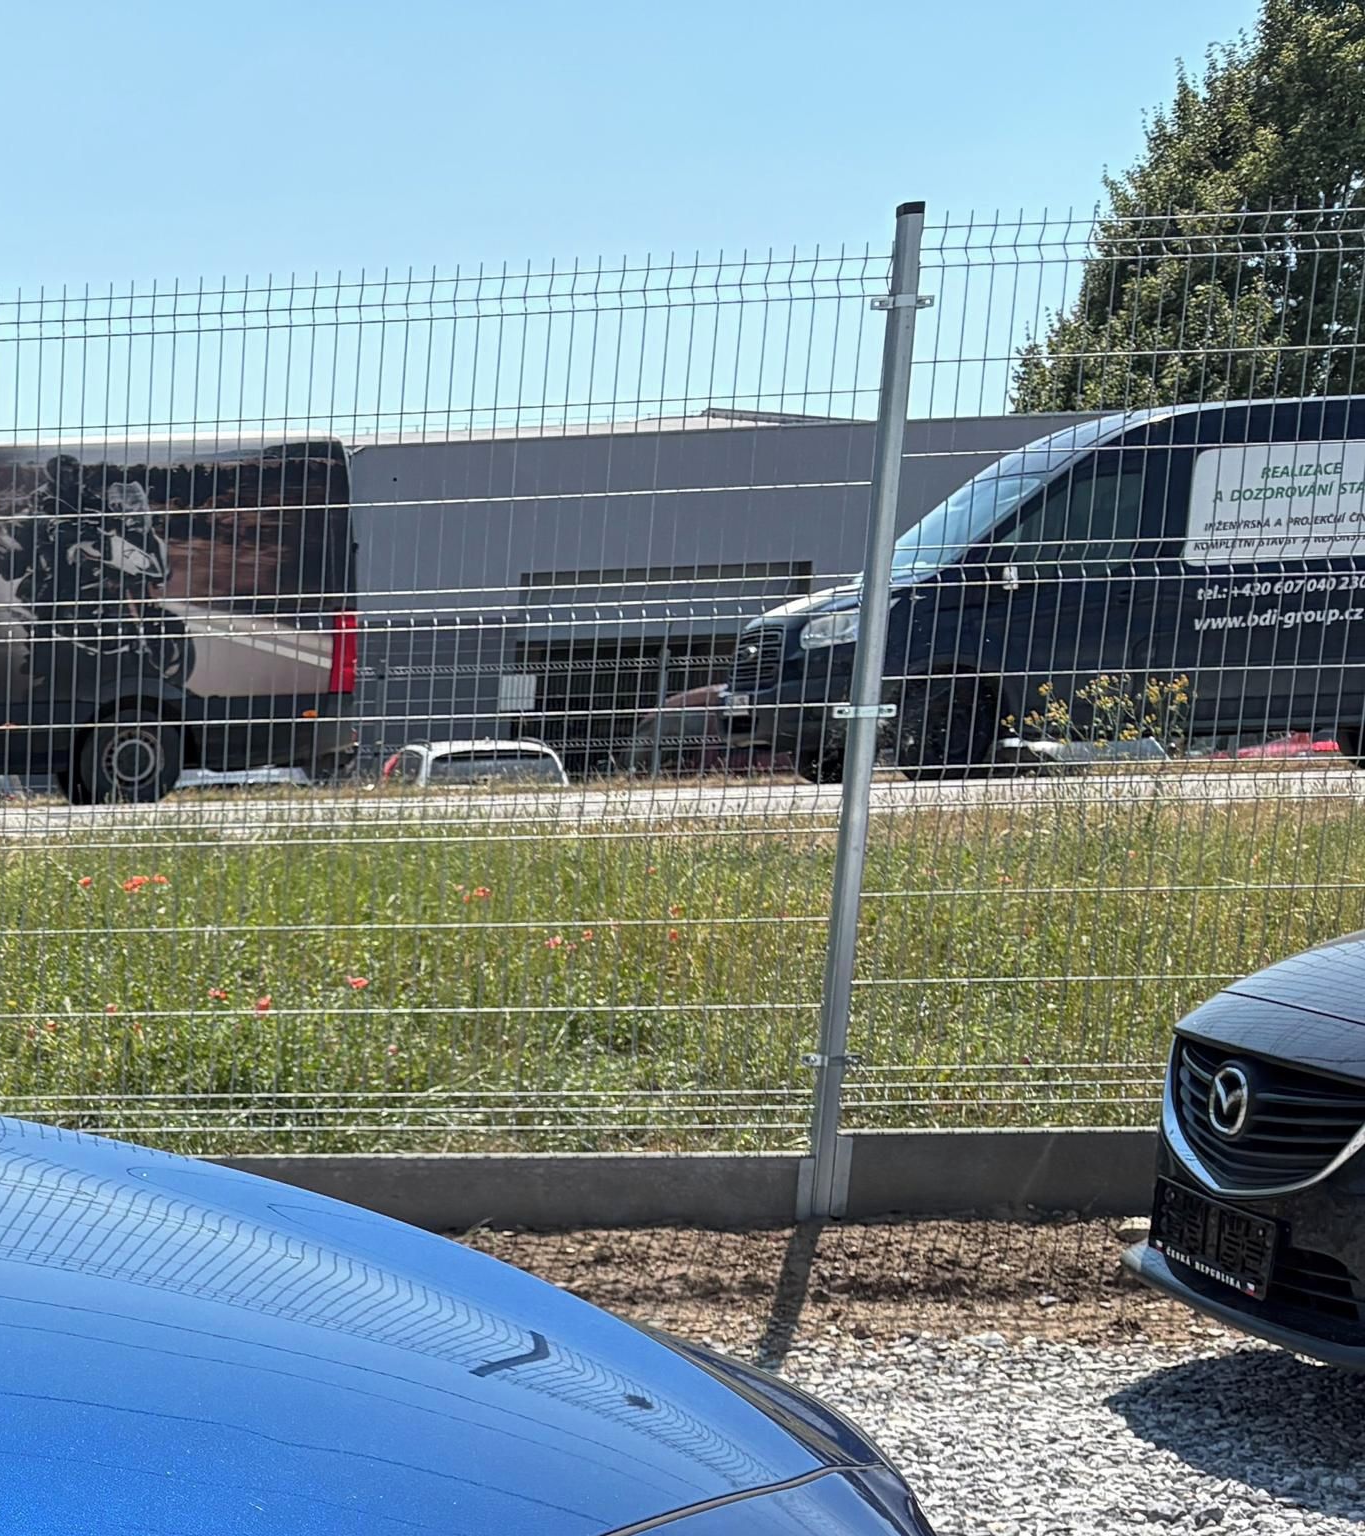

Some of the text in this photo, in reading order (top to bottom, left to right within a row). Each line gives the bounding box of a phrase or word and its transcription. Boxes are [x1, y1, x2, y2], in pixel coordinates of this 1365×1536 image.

[1261, 462, 1342, 479] REALIZACE
[1213, 481, 1365, 502] A DOZOROVÁNÍ STA
[1274, 518, 1282, 527] A
[1349, 511, 1365, 523] ČIN
[1197, 585, 1228, 600] tel.:
[1231, 582, 1272, 597] +420
[1273, 579, 1306, 594] 607
[1307, 577, 1336, 592] 040
[1194, 607, 1365, 631] www.bdi-group.cz
[1165, 1245, 1242, 1290] ČESKÁ REPUBLIKA
